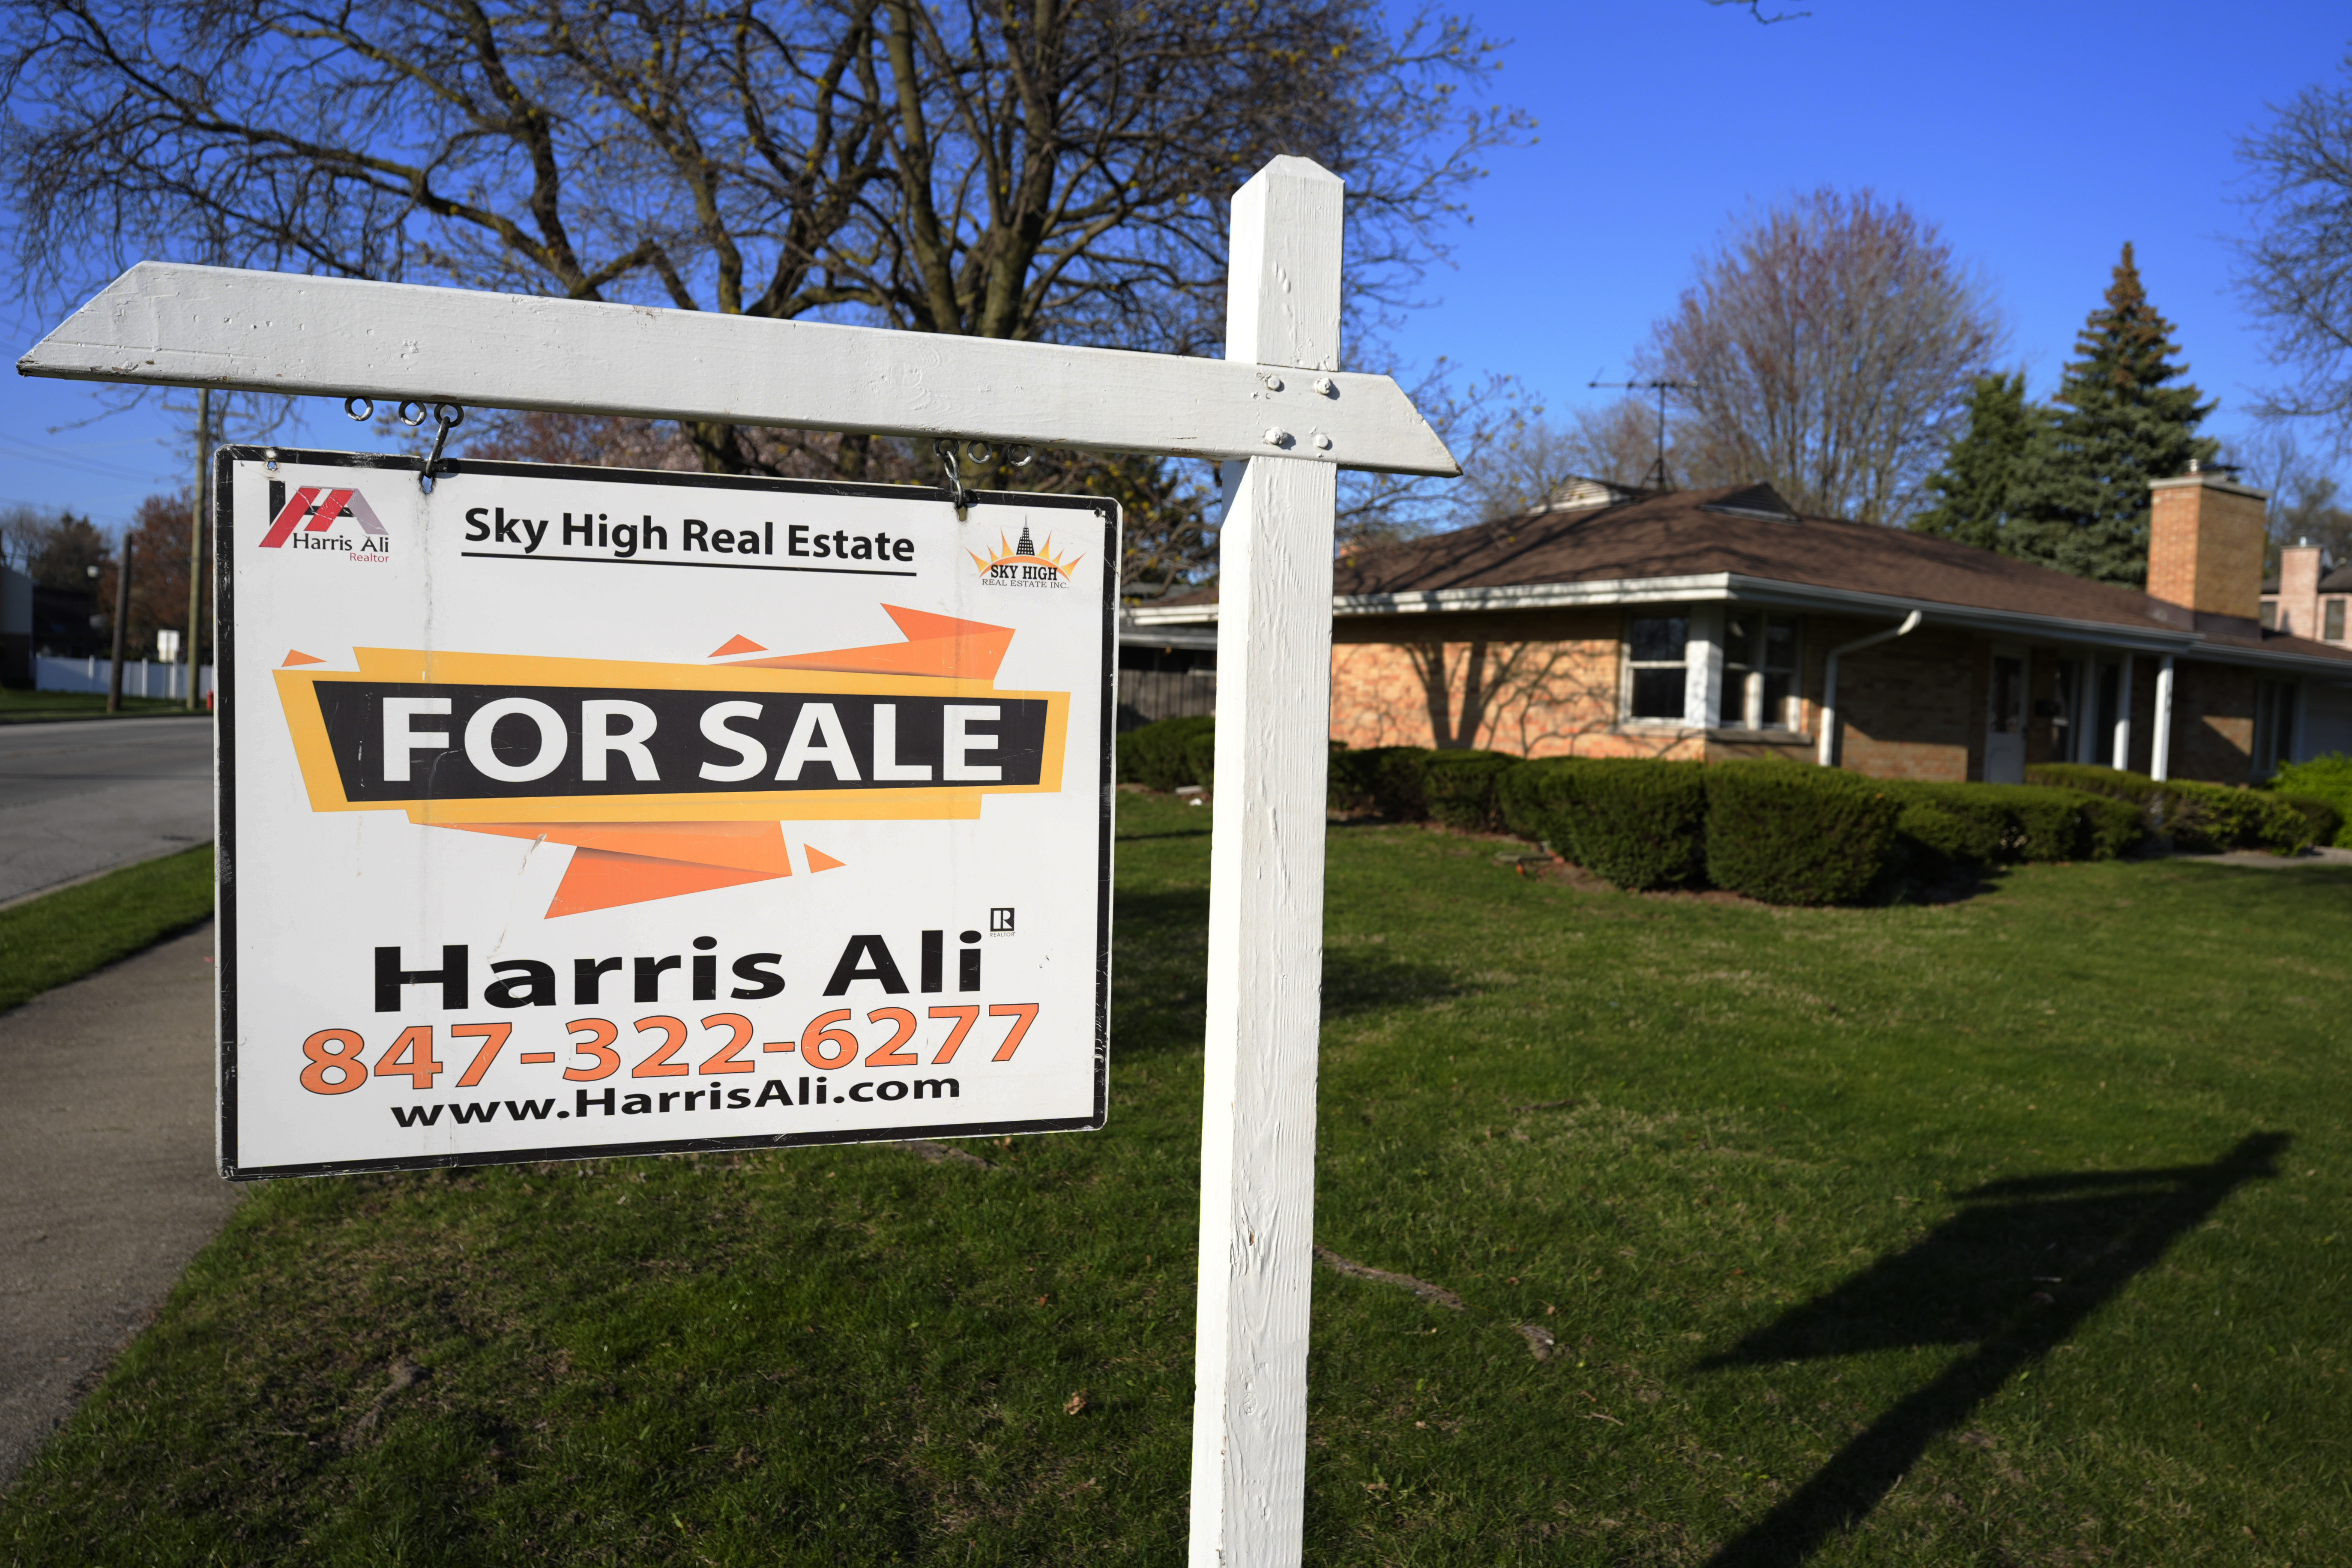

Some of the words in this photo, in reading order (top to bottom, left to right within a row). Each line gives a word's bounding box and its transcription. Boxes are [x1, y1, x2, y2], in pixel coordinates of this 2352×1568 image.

[293, 533, 353, 551] Harris
[360, 536, 389, 553] Ali
[350, 552, 389, 563] Realtor
[465, 507, 549, 554] Sky
[563, 512, 667, 558] High
[683, 519, 773, 555] Real
[788, 524, 914, 562] Estate
[990, 564, 1018, 579] SKY
[1022, 566, 1058, 581] HIGH
[1010, 580, 1047, 588] ESTATE
[383, 697, 661, 783] FOR
[698, 700, 1002, 782] SALE
[374, 935, 786, 1013] Harris
[822, 930, 982, 996] Ali
[300, 1003, 1039, 1095] 847-322-6277
[391, 1077, 960, 1128] www.HarrisAli.com
